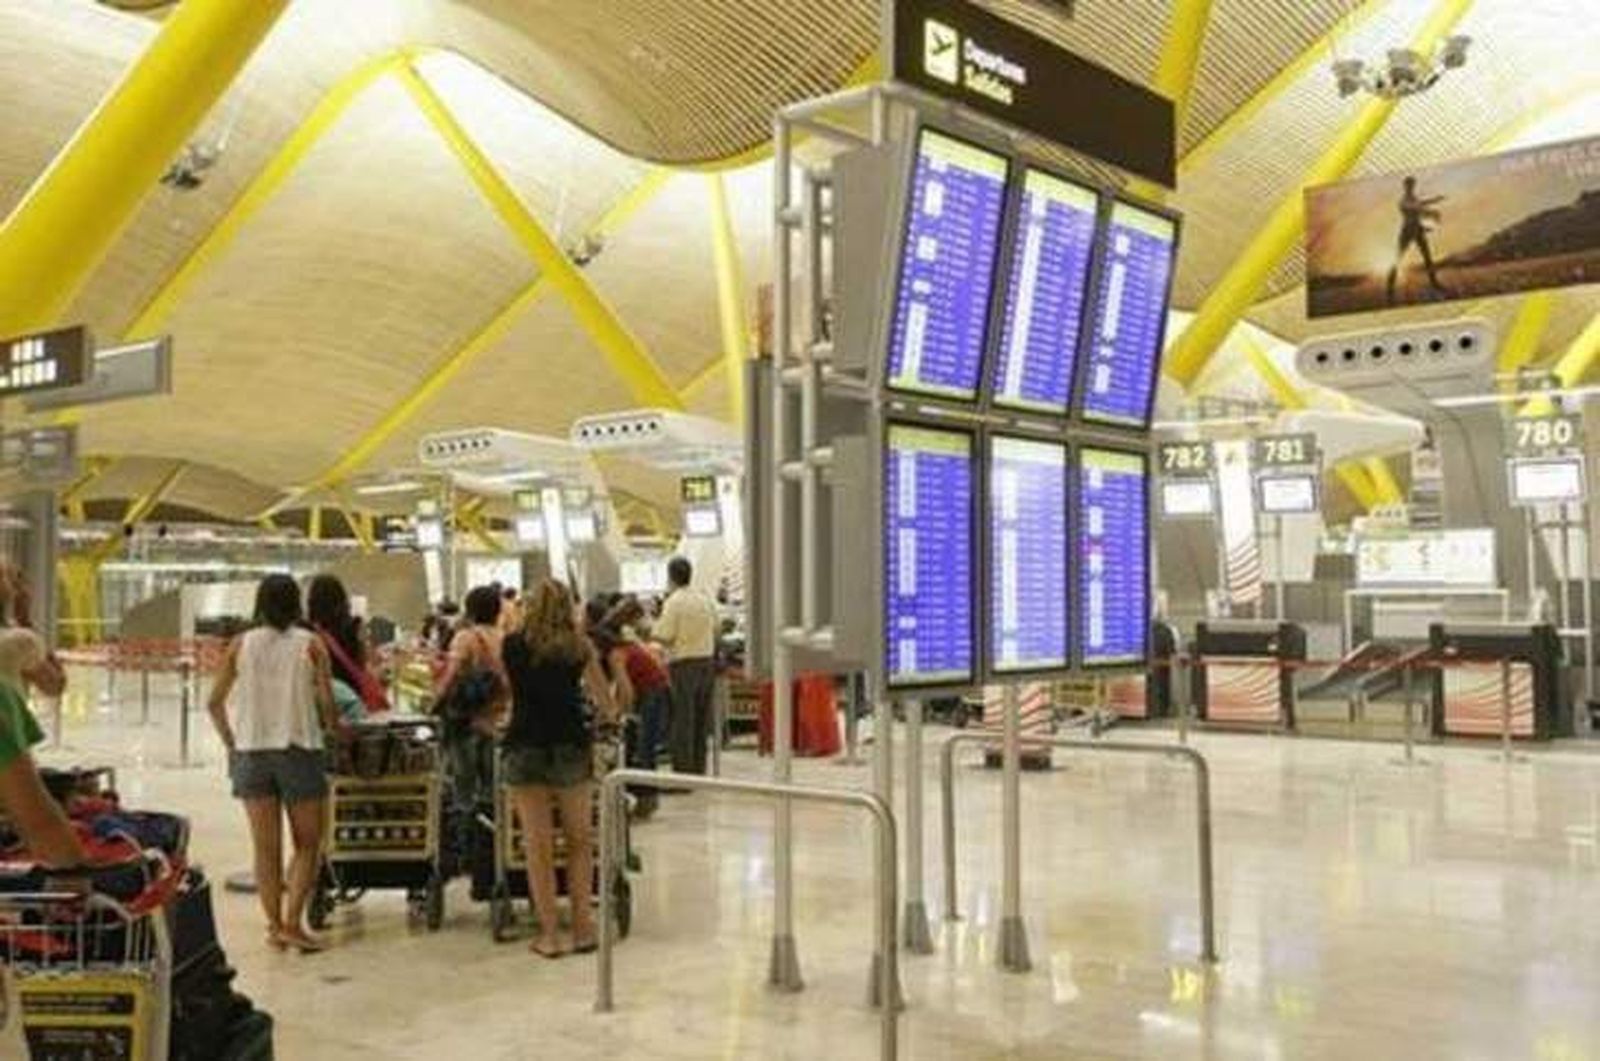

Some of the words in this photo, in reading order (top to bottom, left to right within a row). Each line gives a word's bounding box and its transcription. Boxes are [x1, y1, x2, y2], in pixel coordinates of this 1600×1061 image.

[1515, 419, 1572, 447] 780
[1163, 445, 1206, 469] 782
[1265, 439, 1305, 462] 781
